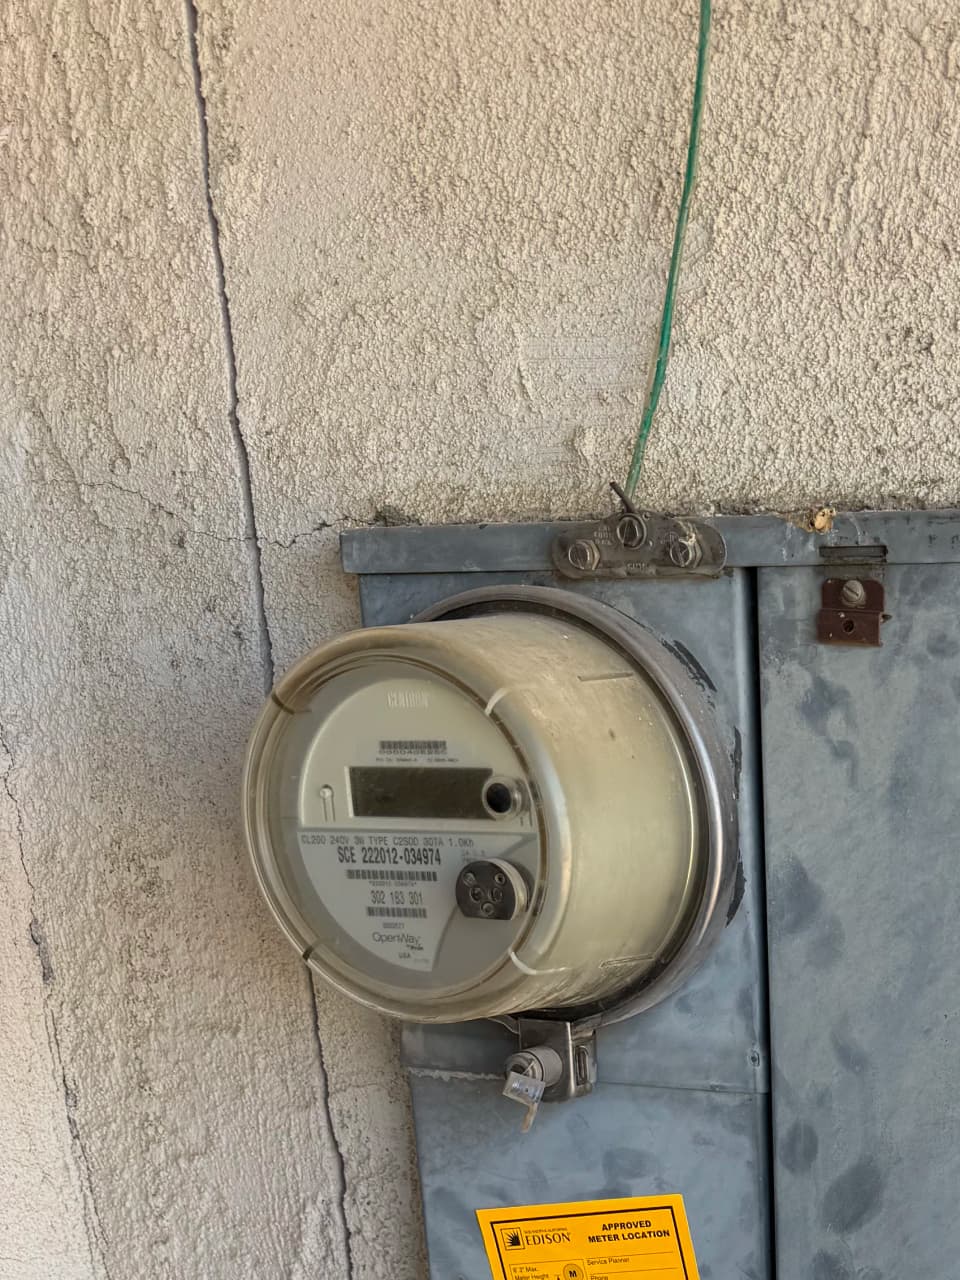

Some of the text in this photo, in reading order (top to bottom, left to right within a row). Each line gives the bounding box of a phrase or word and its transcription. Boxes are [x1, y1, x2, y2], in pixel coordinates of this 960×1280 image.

[369, 836, 388, 846] TYPE
[337, 846, 441, 865] SCE 222012-034974
[370, 890, 424, 905] 302 183 301
[602, 1220, 652, 1231] APPROVED
[525, 1232, 571, 1246] EDISON
[588, 1229, 670, 1243] METER LOCATION
[587, 1257, 630, 1267] Service Planner
[568, 1270, 578, 1279] M
